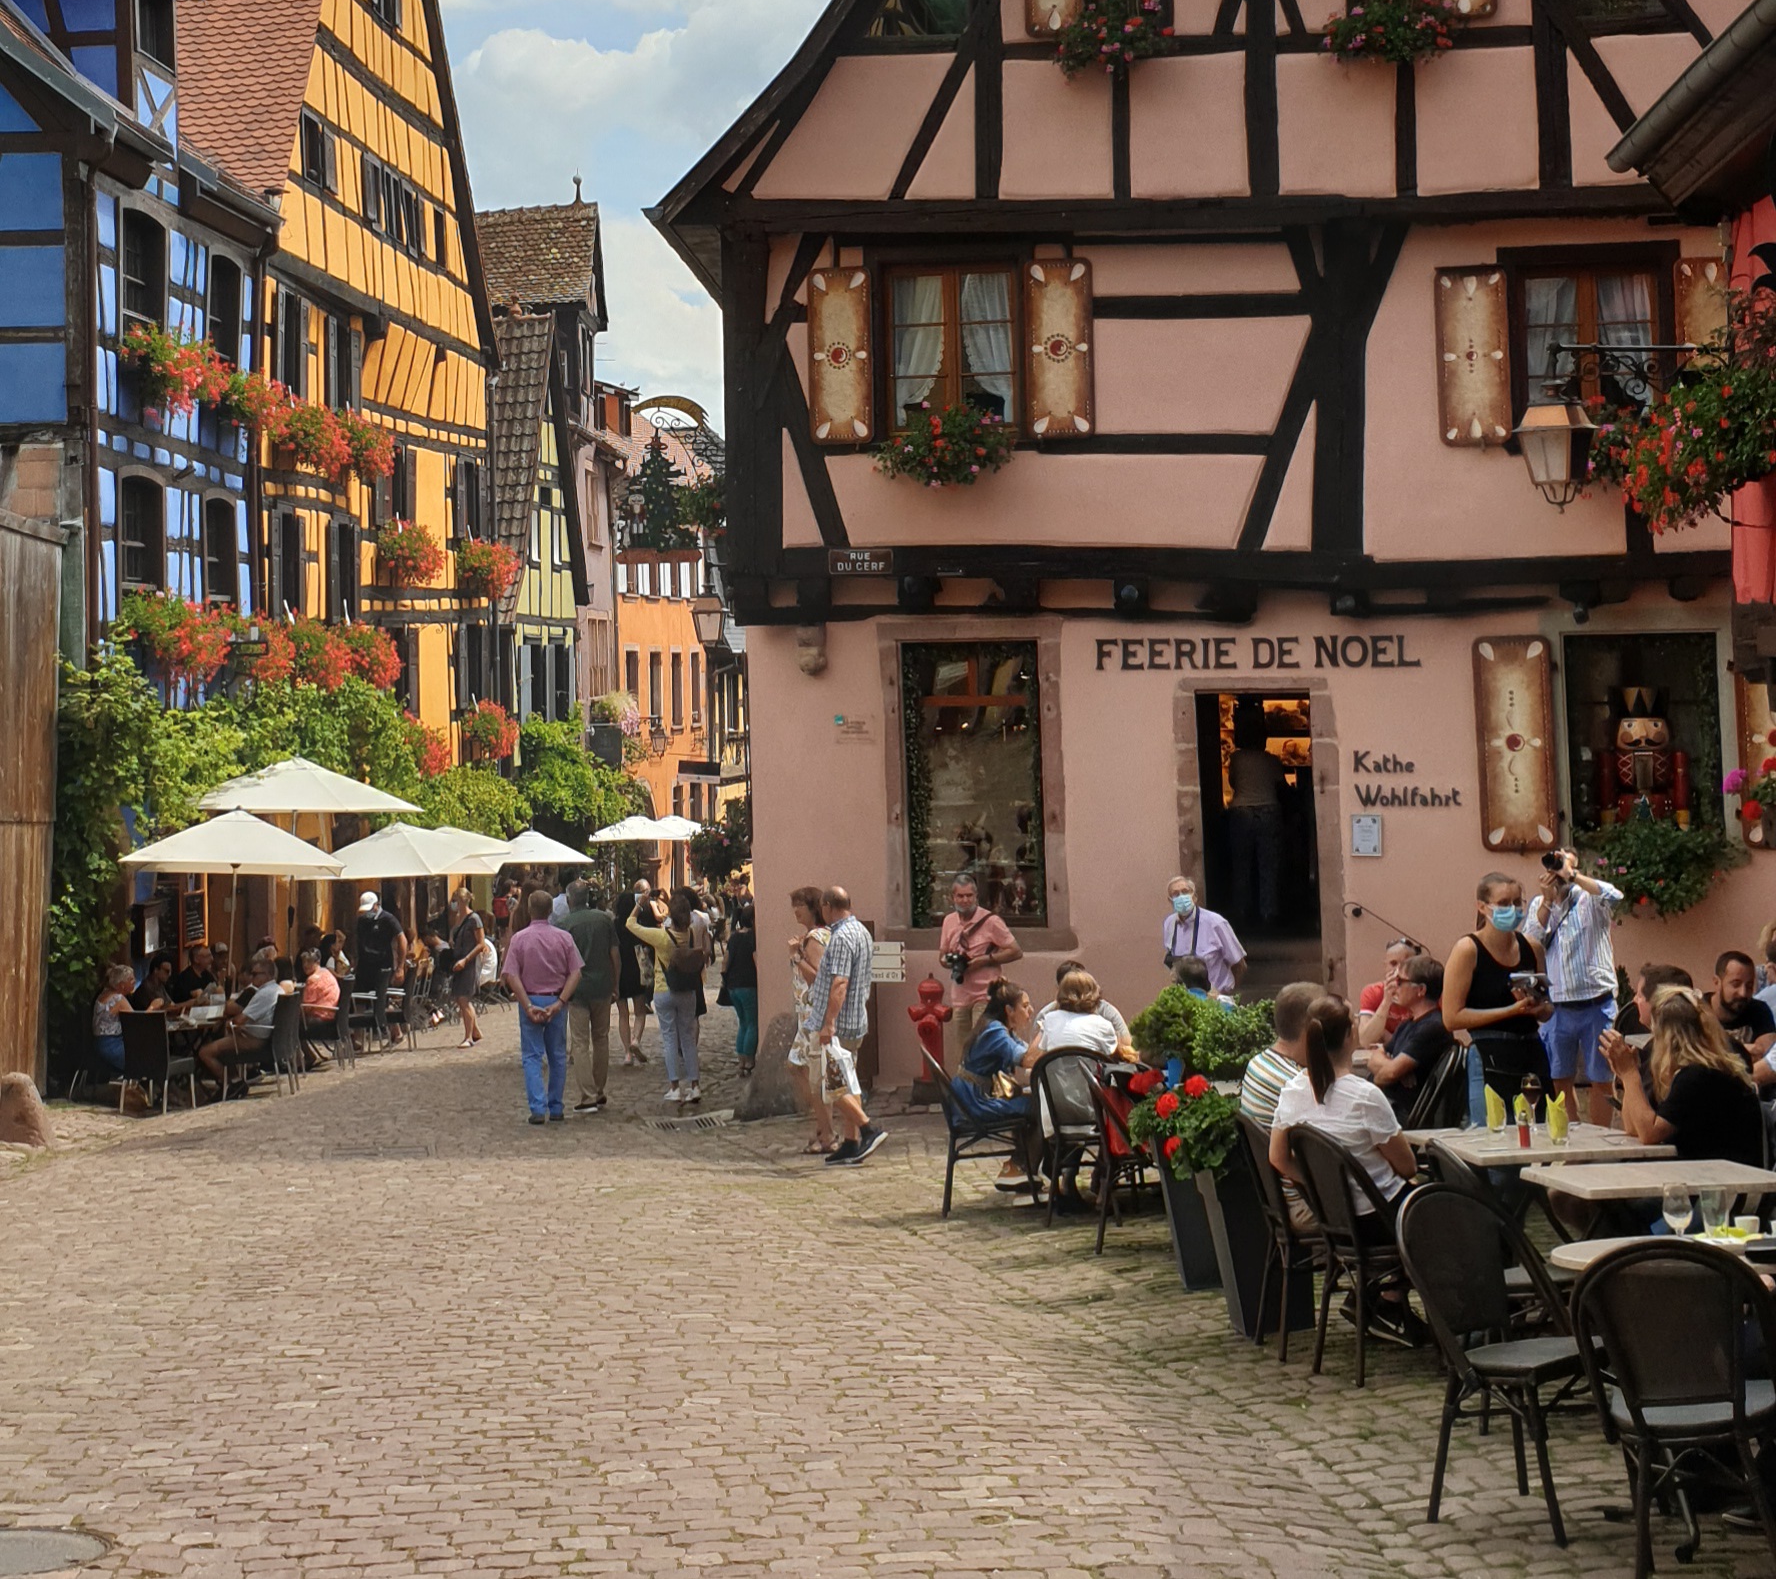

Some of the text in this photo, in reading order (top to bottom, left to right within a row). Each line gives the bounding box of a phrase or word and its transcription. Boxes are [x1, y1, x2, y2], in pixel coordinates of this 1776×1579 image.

[837, 562, 885, 571] DU CERF
[850, 552, 871, 561] RUE
[1095, 634, 1422, 671] FEERIE DE NOEL
[1353, 750, 1415, 773] Kathe
[1354, 784, 1462, 808] Wohlfahrt
